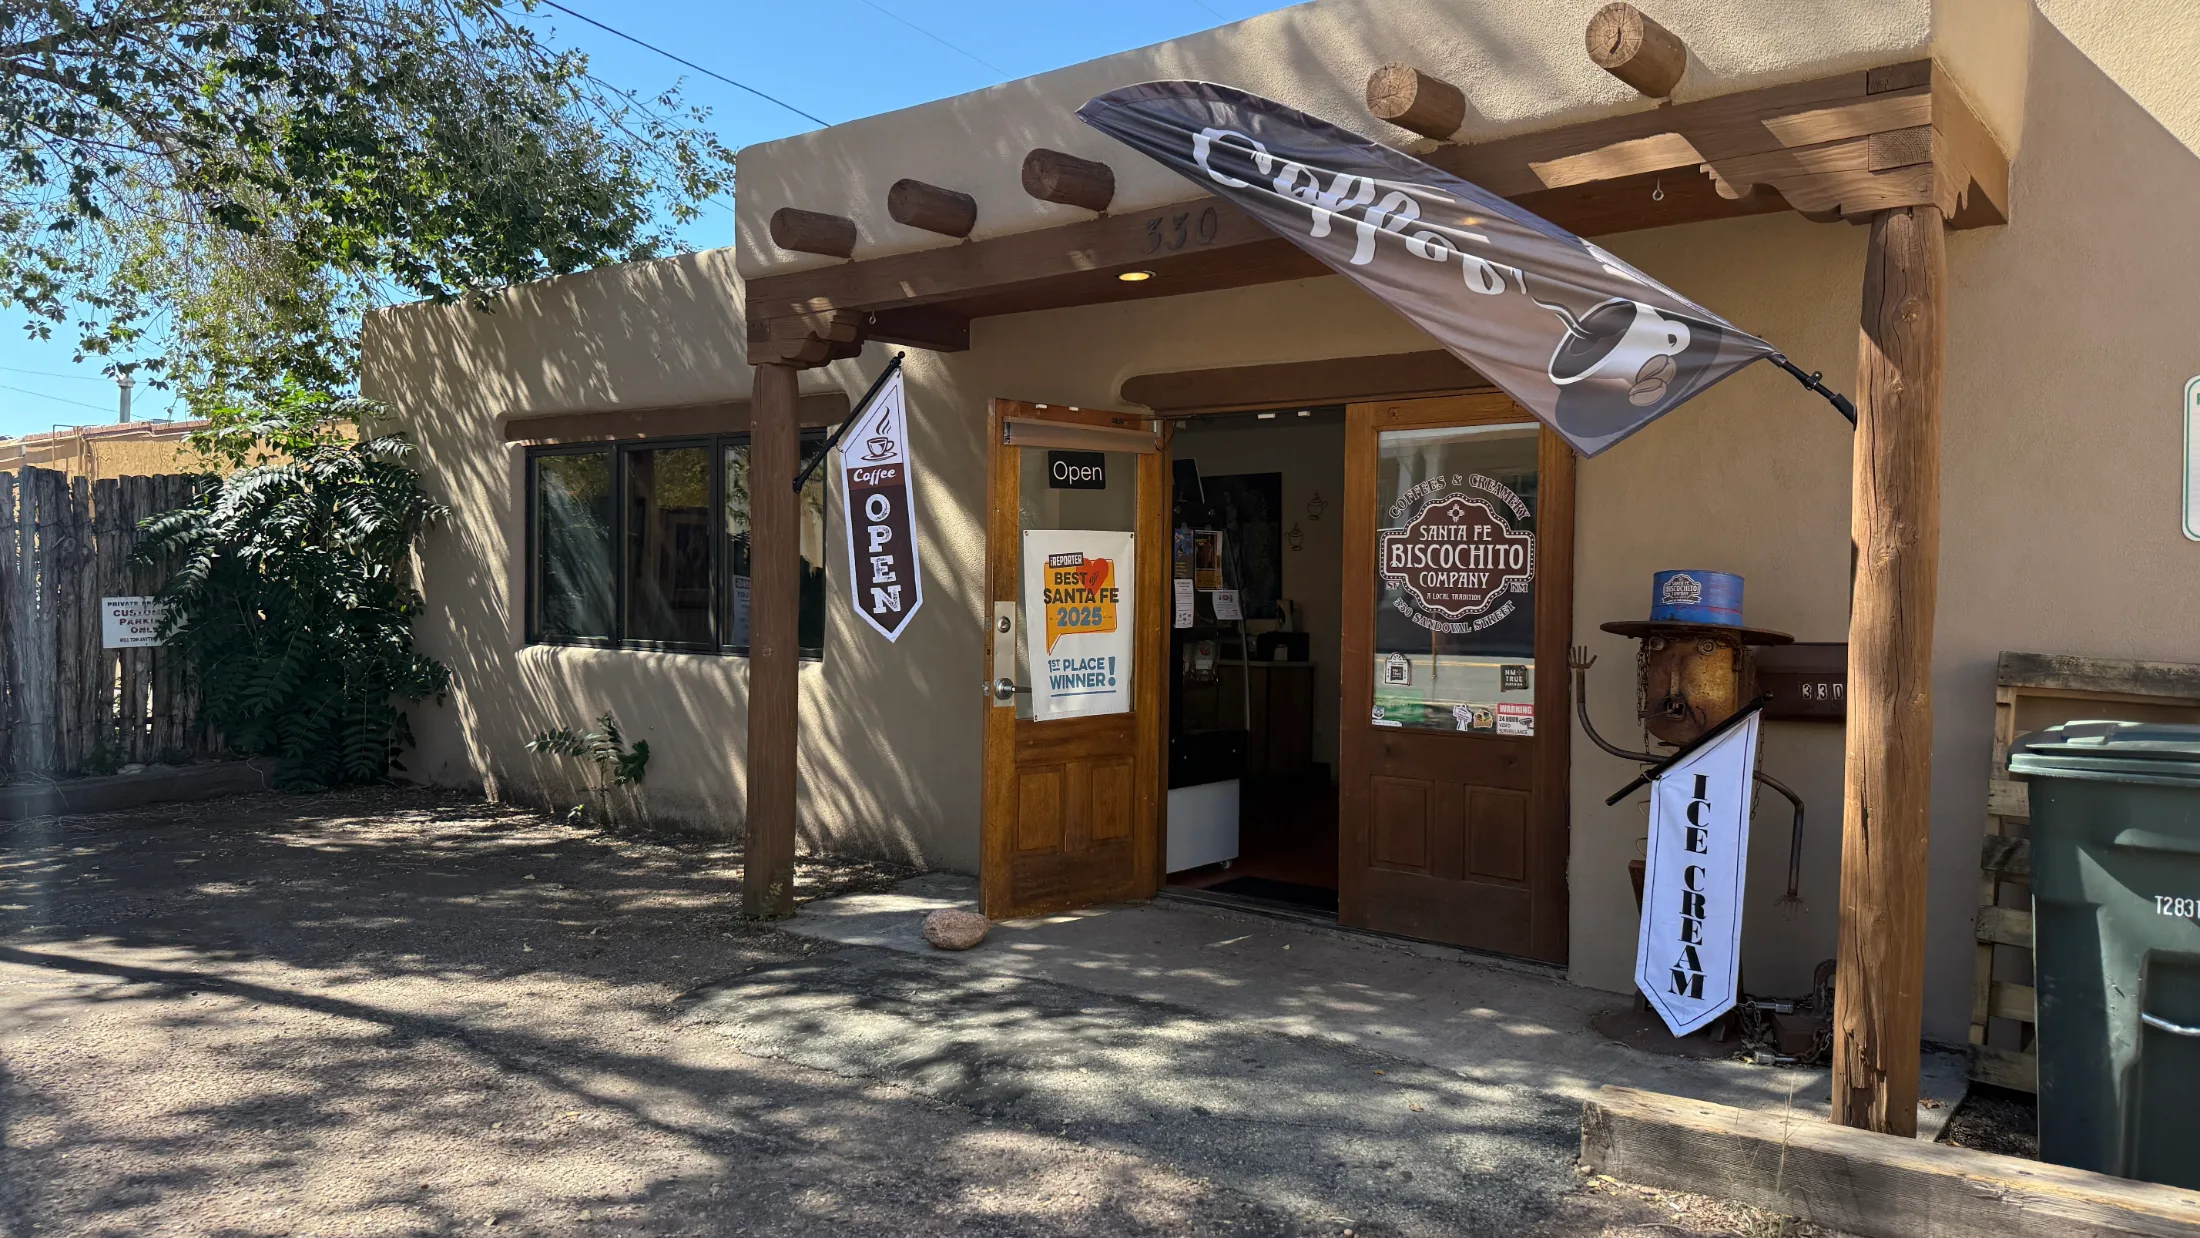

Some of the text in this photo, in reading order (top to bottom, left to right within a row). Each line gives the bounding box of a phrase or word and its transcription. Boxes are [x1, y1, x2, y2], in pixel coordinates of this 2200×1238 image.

[1193, 127, 1528, 295] Coffee
[1143, 206, 1217, 254] 330
[853, 468, 897, 486] Coffee
[1053, 460, 1102, 485] Open
[1389, 474, 1531, 520] COFFEES & CREAMERY
[1420, 525, 1492, 541] SANTA FE
[865, 493, 902, 614] OPEN
[1390, 544, 1524, 569] BISCOCHITO
[1054, 570, 1100, 586] BEST of
[1420, 571, 1490, 589] COMPANY
[1043, 587, 1119, 604] SANTA FE
[1426, 592, 1432, 600] A
[1451, 593, 1481, 601] TRADITION
[1510, 582, 1529, 593] NM
[1057, 606, 1103, 627] 2025
[1411, 612, 1472, 633] SANDOVAL
[1472, 600, 1516, 631] STREET
[1048, 657, 1105, 673] 1ST PLACE
[1505, 676, 1523, 684] TRUE
[1803, 684, 1843, 699] 330
[1499, 704, 1533, 715] WARNING
[1668, 773, 1712, 1000] ICE CREAM
